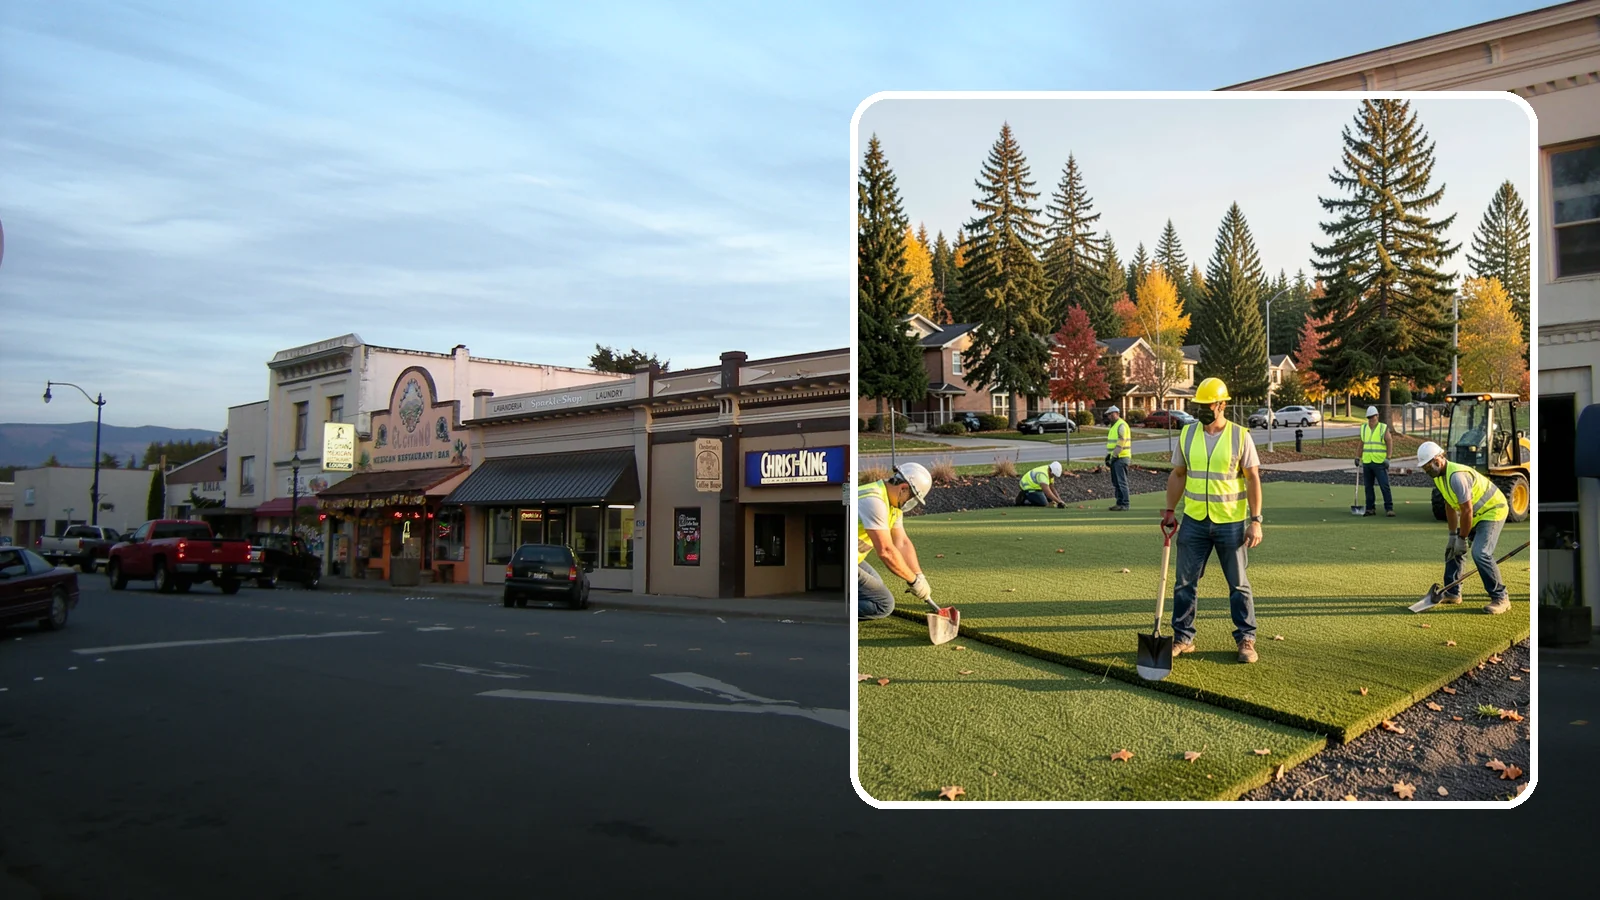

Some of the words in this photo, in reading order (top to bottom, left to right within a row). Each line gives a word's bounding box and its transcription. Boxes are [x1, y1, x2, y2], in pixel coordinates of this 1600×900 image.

[562, 394, 582, 404] Shop
[595, 389, 623, 400] LAUNDRY
[373, 455, 396, 464] MEXICAN
[397, 451, 434, 462] RESTAURANT
[438, 450, 450, 459] BAR
[761, 452, 797, 477] CHRIST
[799, 450, 827, 476] KING
[710, 481, 722, 489] House
